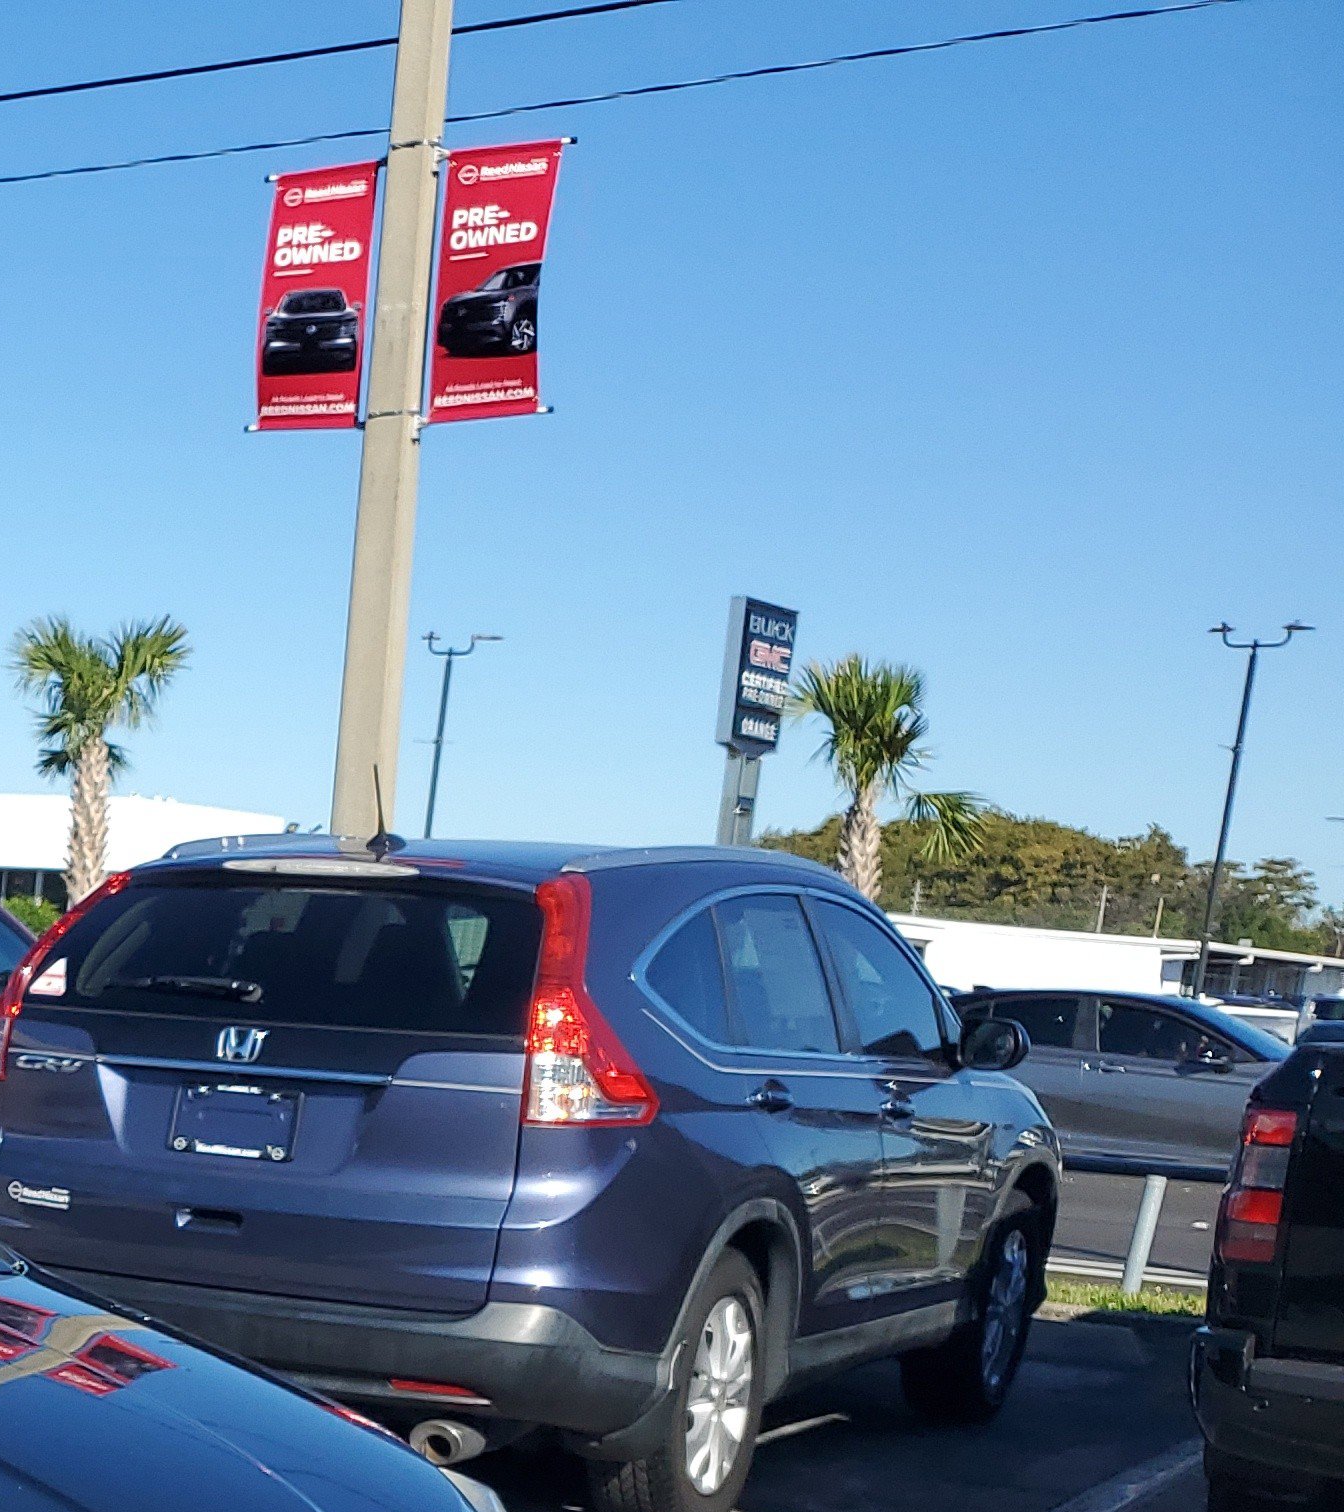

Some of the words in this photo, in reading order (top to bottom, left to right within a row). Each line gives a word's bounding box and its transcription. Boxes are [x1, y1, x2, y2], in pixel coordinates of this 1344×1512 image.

[452, 204, 510, 229] PRE-
[277, 222, 336, 247] PRE-
[449, 221, 538, 250] OWNED
[274, 241, 361, 267] OWNED
[749, 612, 795, 642] BUICK
[749, 639, 792, 674] GMC
